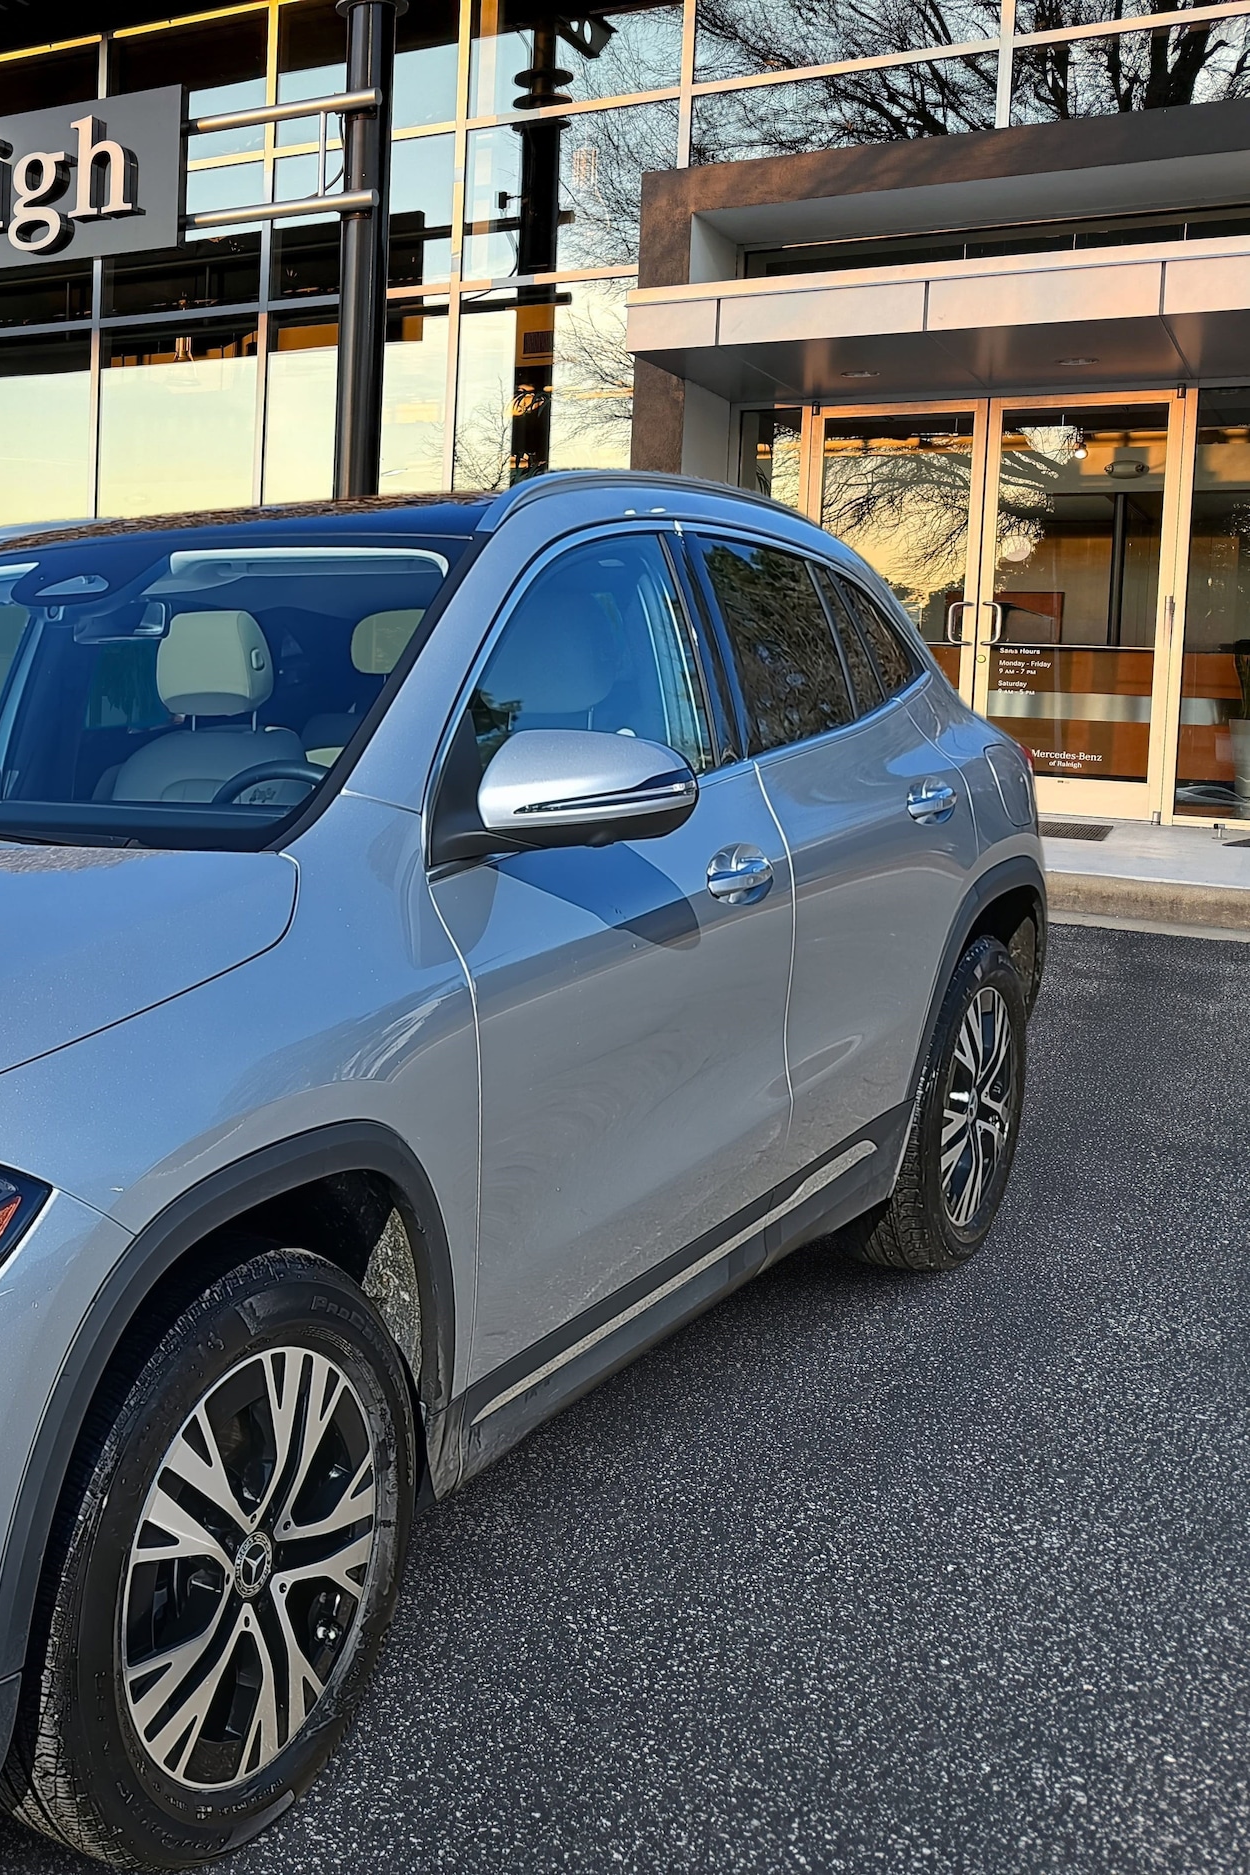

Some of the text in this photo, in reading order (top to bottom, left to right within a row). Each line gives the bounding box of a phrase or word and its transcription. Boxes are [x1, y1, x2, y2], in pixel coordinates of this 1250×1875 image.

[998, 660, 1025, 668] Monday
[1030, 661, 1051, 669] Friday
[997, 680, 1028, 688] Saturday
[1031, 748, 1103, 762] Mercedes-Benz
